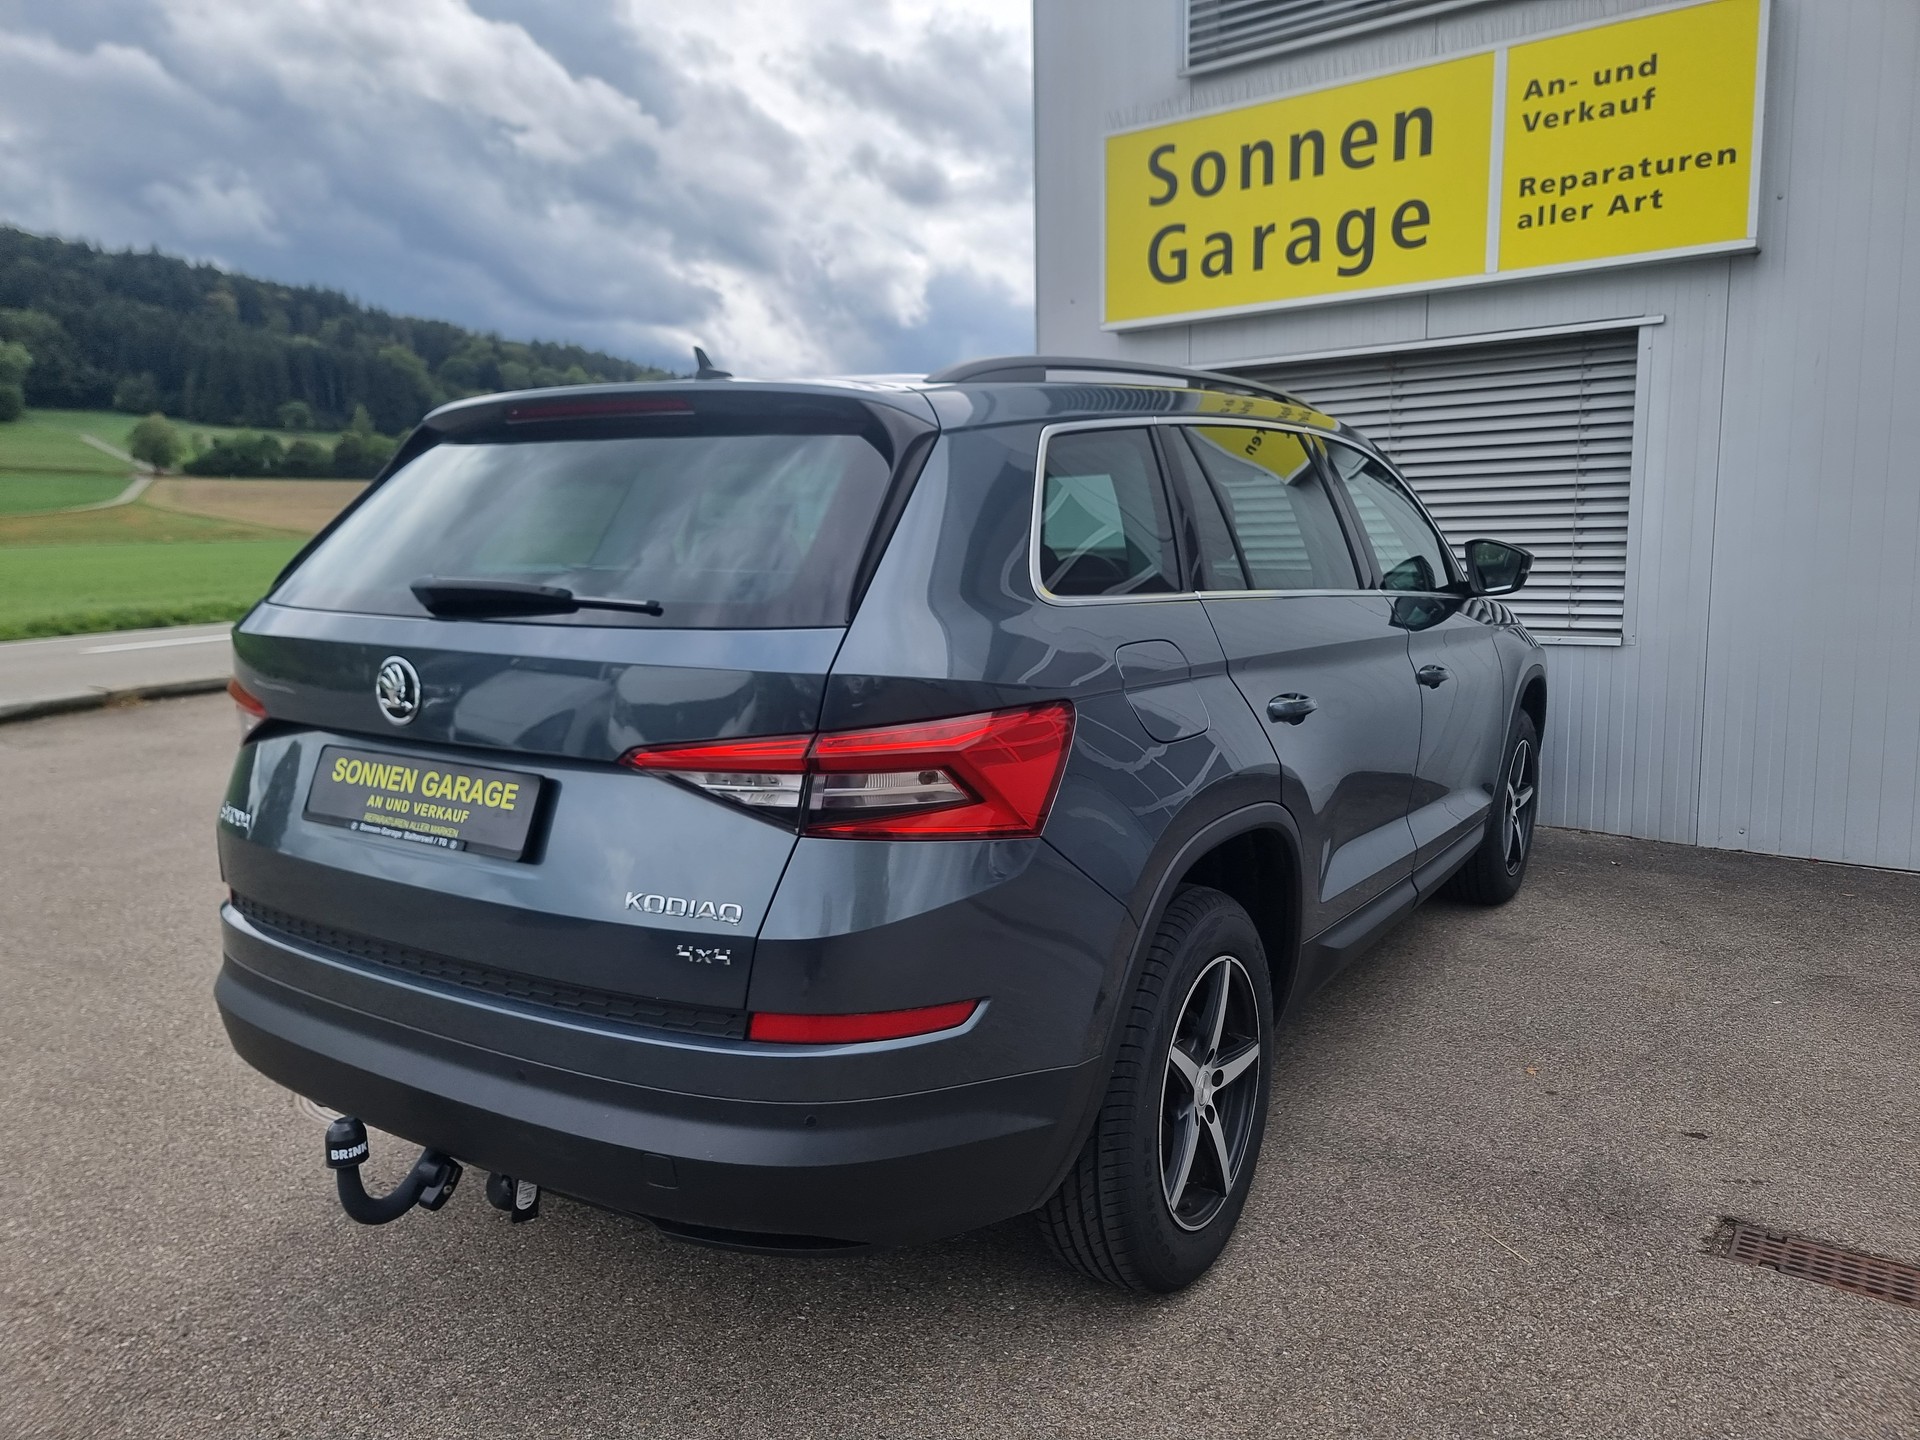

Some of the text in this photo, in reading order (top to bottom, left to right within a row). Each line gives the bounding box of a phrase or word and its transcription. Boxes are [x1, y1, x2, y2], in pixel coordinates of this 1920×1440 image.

[1522, 53, 1658, 102] An- und
[1521, 87, 1656, 133] Verkauf
[1146, 103, 1434, 208] Sonnen
[1518, 147, 1738, 198] Reparaturen
[1516, 188, 1663, 230] aller Art
[1146, 196, 1432, 285] Garage
[332, 757, 519, 810] SONNEN GARAGE
[366, 795, 470, 823] AN UND VERKAUF
[624, 891, 743, 926] KODIAQ
